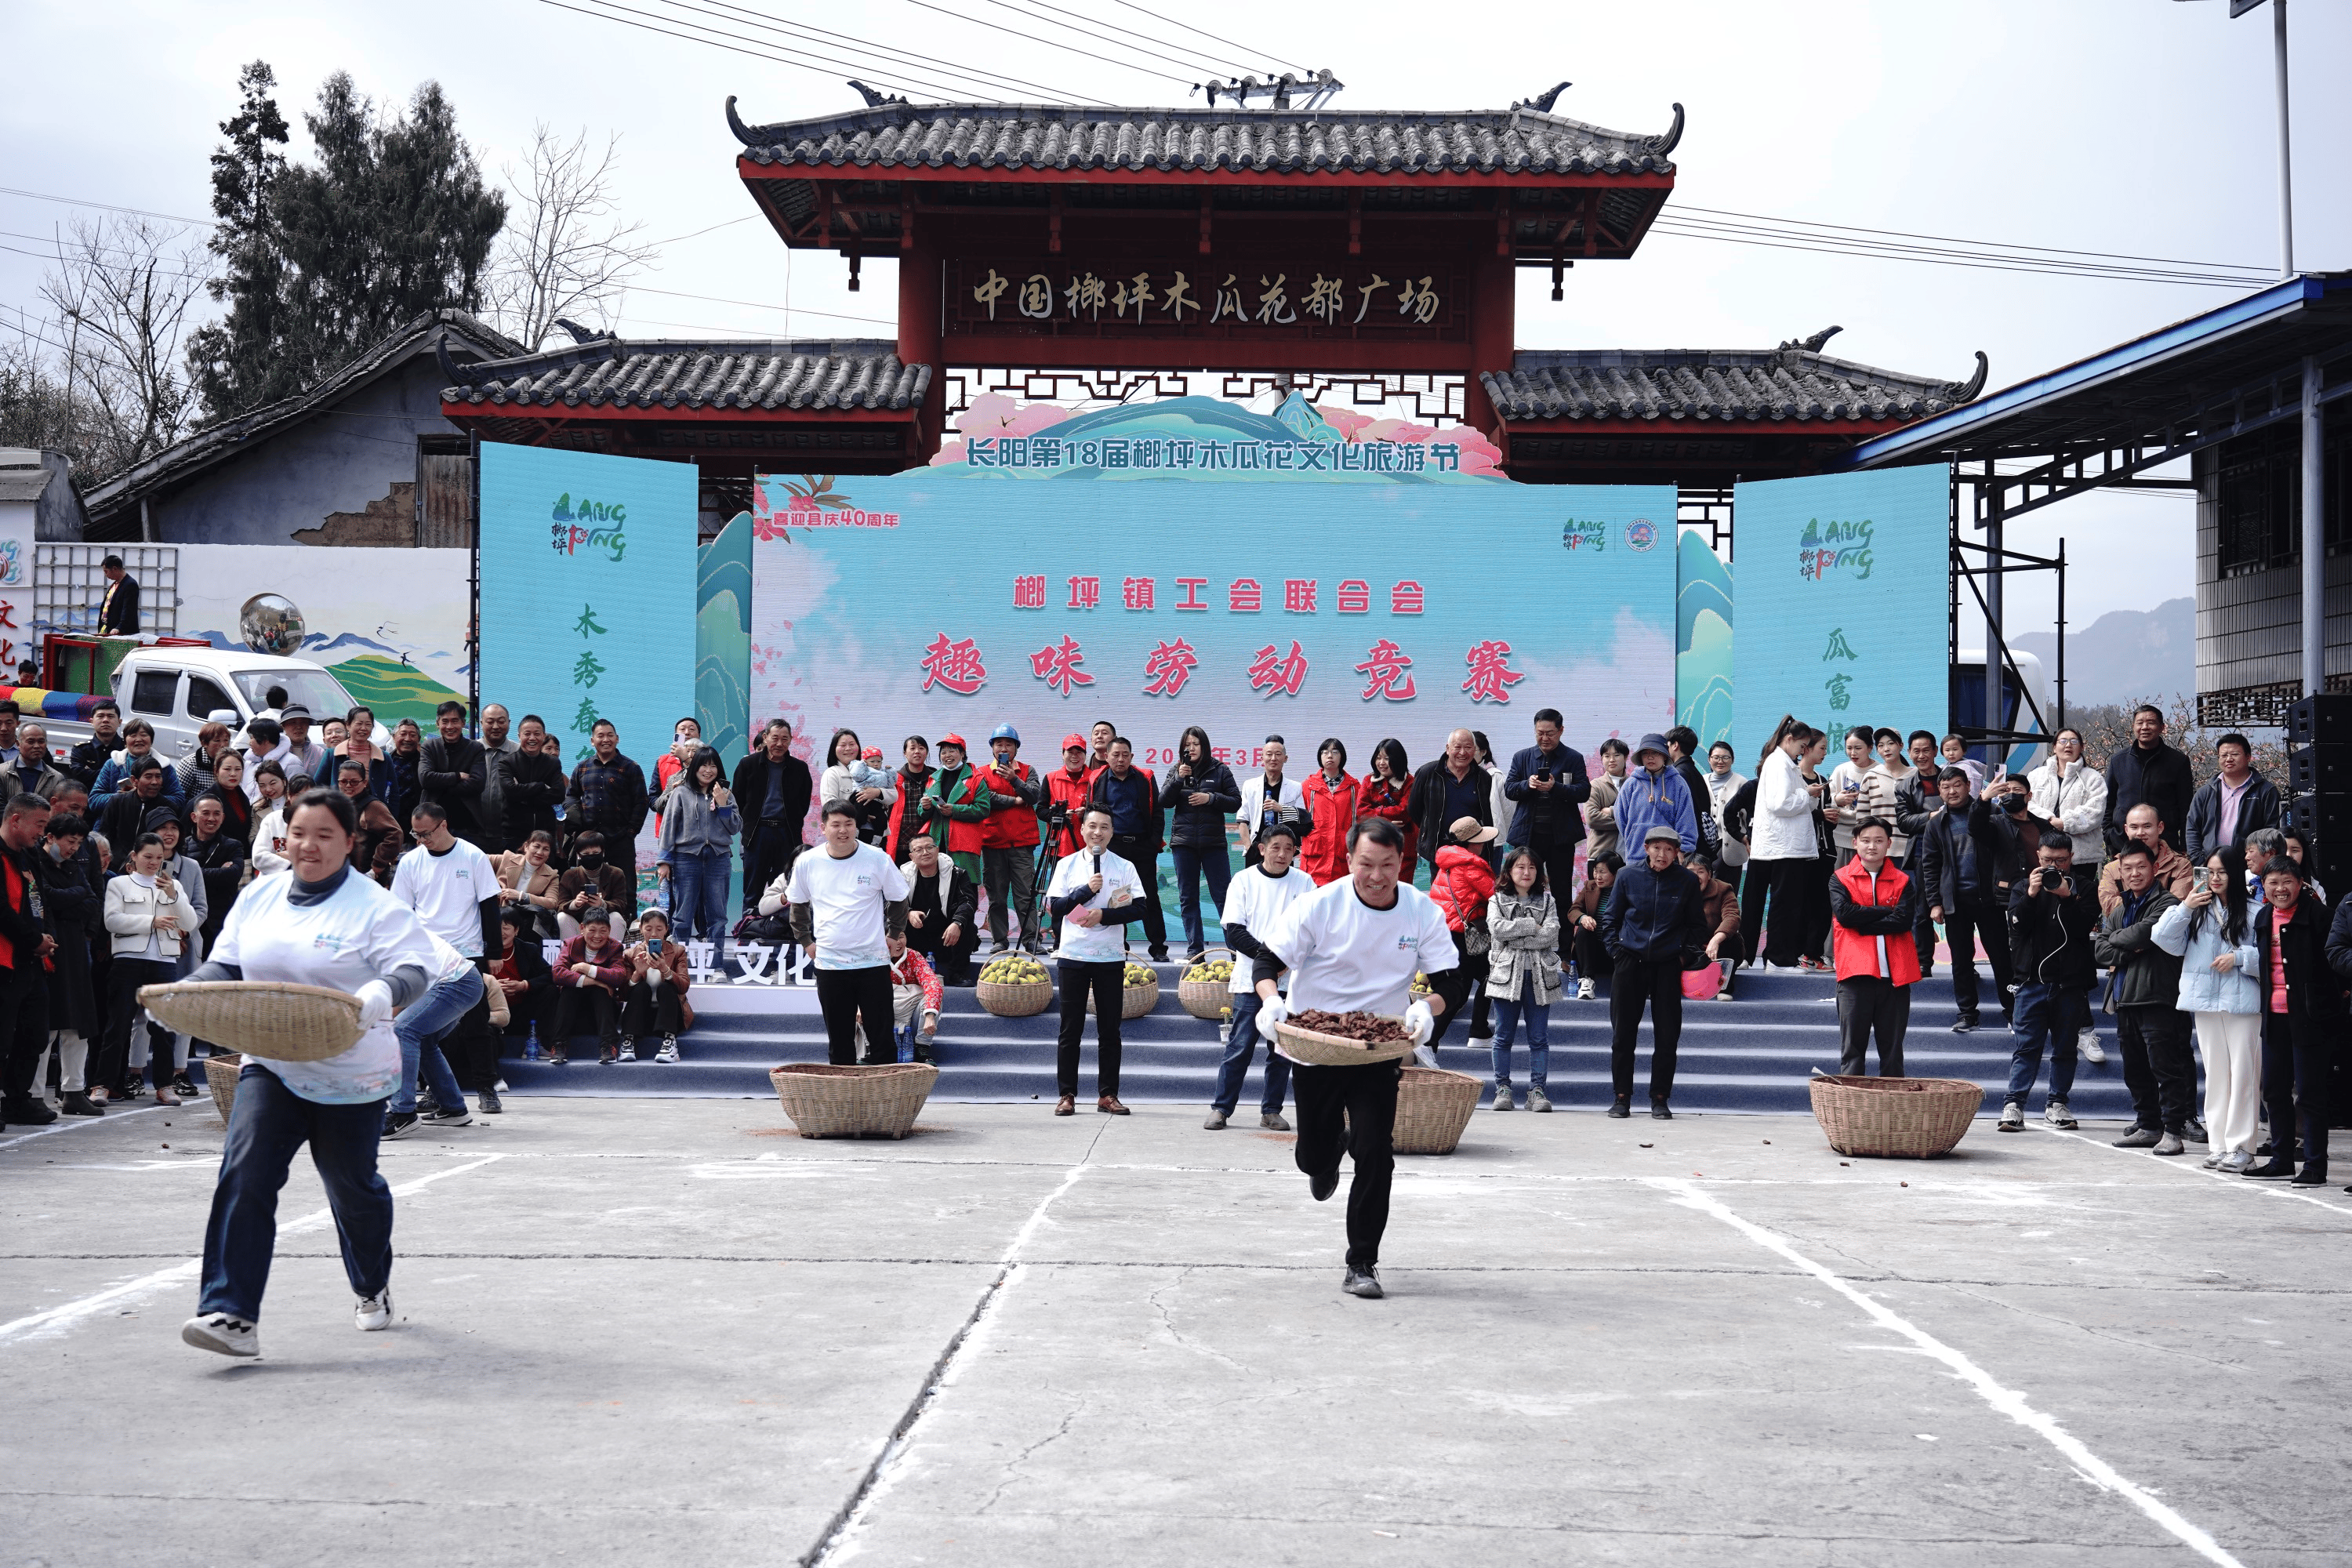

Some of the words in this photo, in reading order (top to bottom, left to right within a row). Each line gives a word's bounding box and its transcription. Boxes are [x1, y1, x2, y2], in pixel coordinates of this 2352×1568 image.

[974, 268, 1439, 325] 中国榔坪木瓜花都广场
[967, 437, 1459, 472] 长阳第18届榔坪木瓜花文化旅游节
[773, 510, 899, 526] 喜迎县庆40周年
[552, 521, 568, 555] 榔坪
[1799, 549, 1816, 582] 榔坪
[1014, 576, 1425, 614] 榔坪镇工会联合会
[923, 633, 1526, 703] 趣味劳动竞赛
